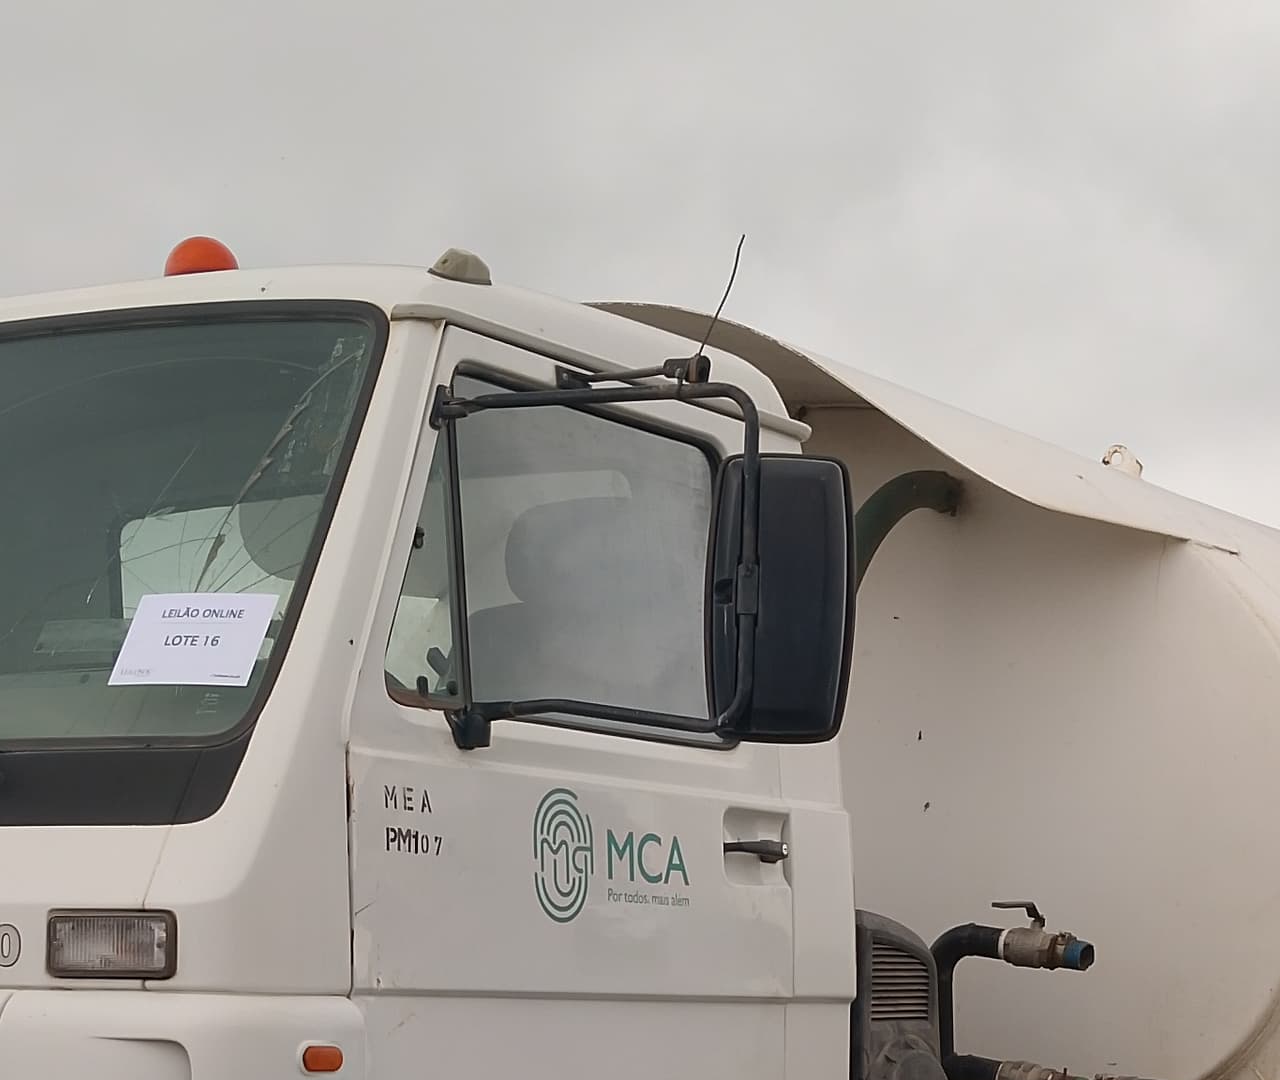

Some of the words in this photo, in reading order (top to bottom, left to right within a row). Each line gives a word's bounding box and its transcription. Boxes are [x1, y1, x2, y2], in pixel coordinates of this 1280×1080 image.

[161, 607, 200, 618] LEILÃO
[202, 608, 245, 619] ONLINE
[164, 635, 200, 646] LOTE
[204, 635, 221, 647] 16
[385, 826, 443, 857] PM107
[606, 828, 690, 886] MCA
[607, 887, 622, 902] Por
